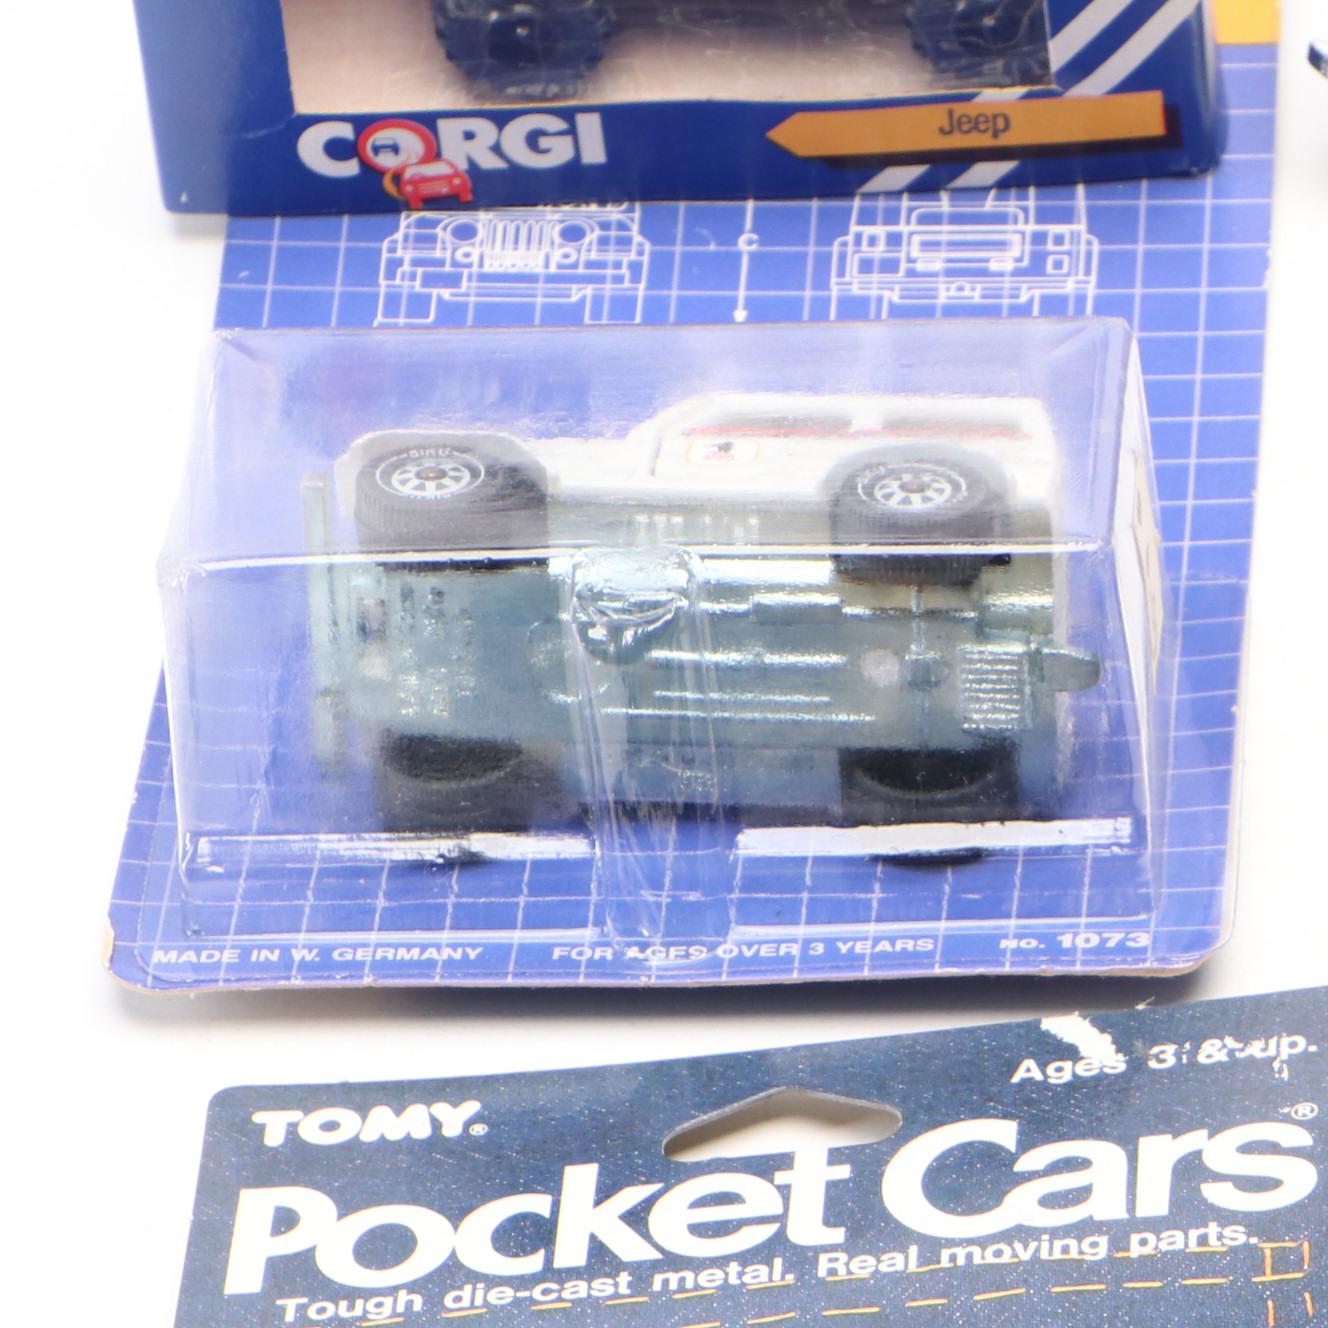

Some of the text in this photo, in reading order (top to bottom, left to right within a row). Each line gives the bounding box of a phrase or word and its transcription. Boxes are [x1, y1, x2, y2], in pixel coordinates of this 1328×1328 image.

[938, 108, 1011, 138] Jeep
[297, 112, 607, 177] CORGI
[152, 947, 484, 964] MADE IN W. GERMANY
[552, 938, 935, 961] FOR AGES OVER 3 YEARS
[1056, 932, 1151, 949] 1073
[1010, 1055, 1128, 1085] Ages
[1147, 1043, 1180, 1069] 3
[1197, 1037, 1231, 1065] &
[224, 1117, 1318, 1296] Pocket Cars
[276, 1221, 1260, 1323] Tough die-cast metal. Real moving parts.
